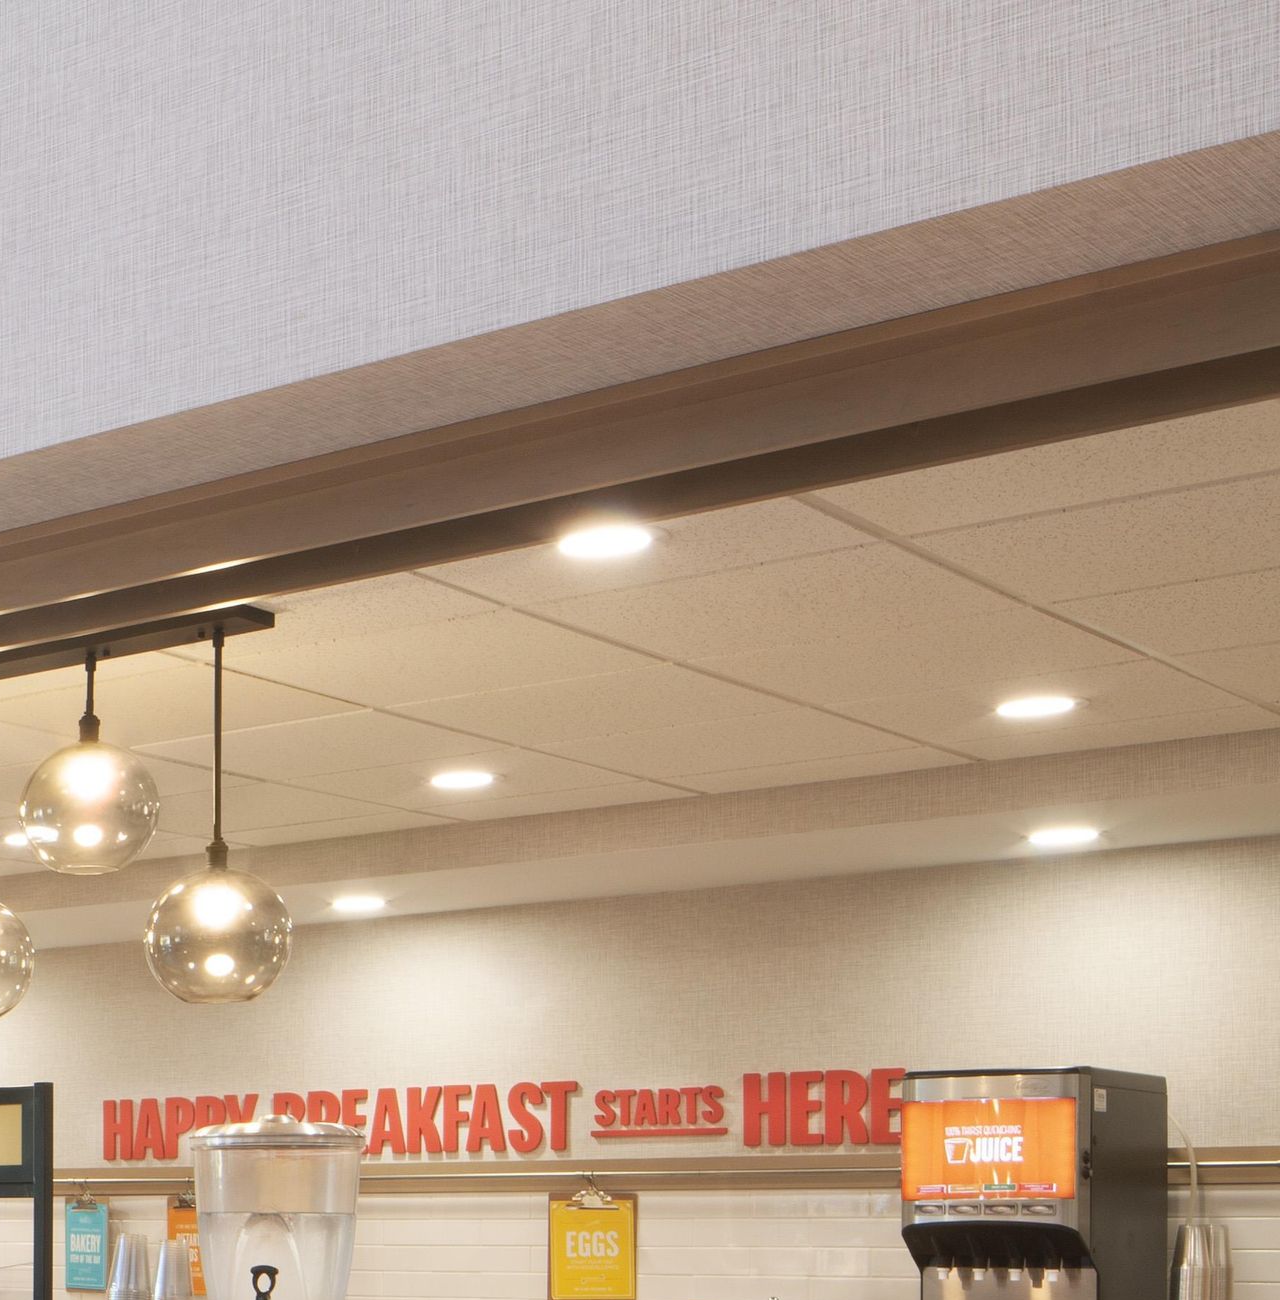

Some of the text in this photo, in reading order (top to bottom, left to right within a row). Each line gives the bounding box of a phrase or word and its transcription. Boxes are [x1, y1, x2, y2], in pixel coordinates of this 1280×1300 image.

[594, 1085, 725, 1127] STARTS
[743, 1068, 905, 1146] HERE
[970, 1137, 1024, 1162] JUICE
[70, 1233, 101, 1253] BAKERY
[566, 1230, 619, 1258] EGGS
